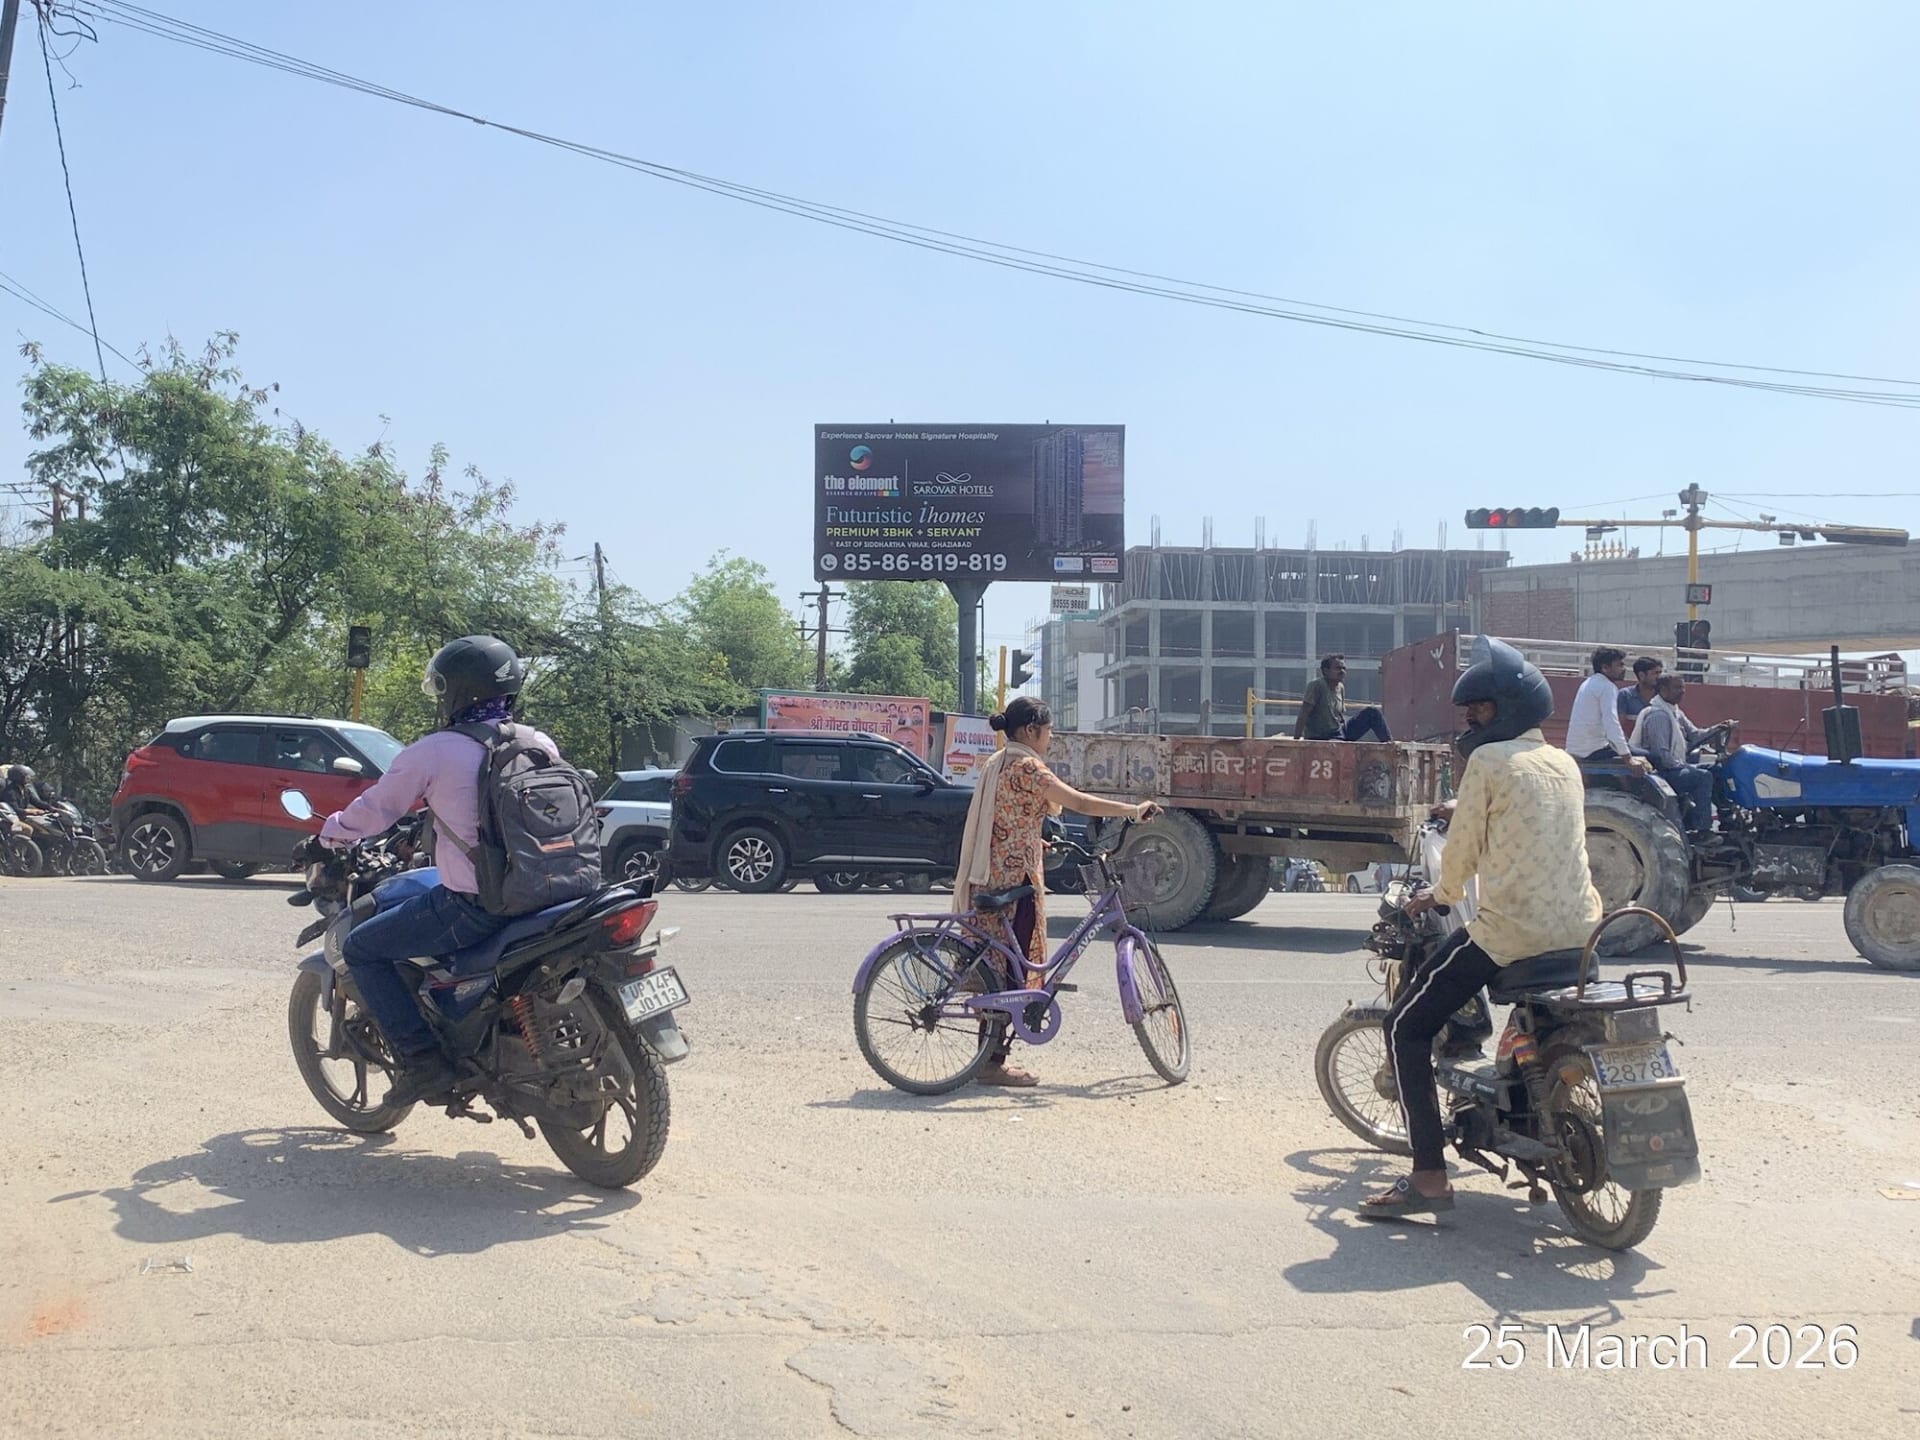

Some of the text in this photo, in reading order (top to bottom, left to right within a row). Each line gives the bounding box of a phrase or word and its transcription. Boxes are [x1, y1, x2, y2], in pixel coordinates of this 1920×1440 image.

[821, 432, 1000, 441] Experience Sarovar Hotels Signature Hospitality
[824, 475, 899, 490] the element
[913, 485, 994, 495] SAROVAR HOTELS
[825, 501, 986, 524] Futuristic ihomes
[826, 527, 880, 537] PREMIUM
[882, 527, 914, 537] 3BHK
[926, 527, 982, 537] SERVANT
[931, 541, 973, 549] GHAZIABAD
[843, 553, 1007, 572] 85-86-819-819
[811, 716, 823, 731] श्री
[825, 716, 849, 732] गौरव
[880, 719, 892, 734] जी
[1310, 759, 1333, 779] 23
[1077, 922, 1104, 955] AVON
[1607, 1061, 1664, 1083] 2878
